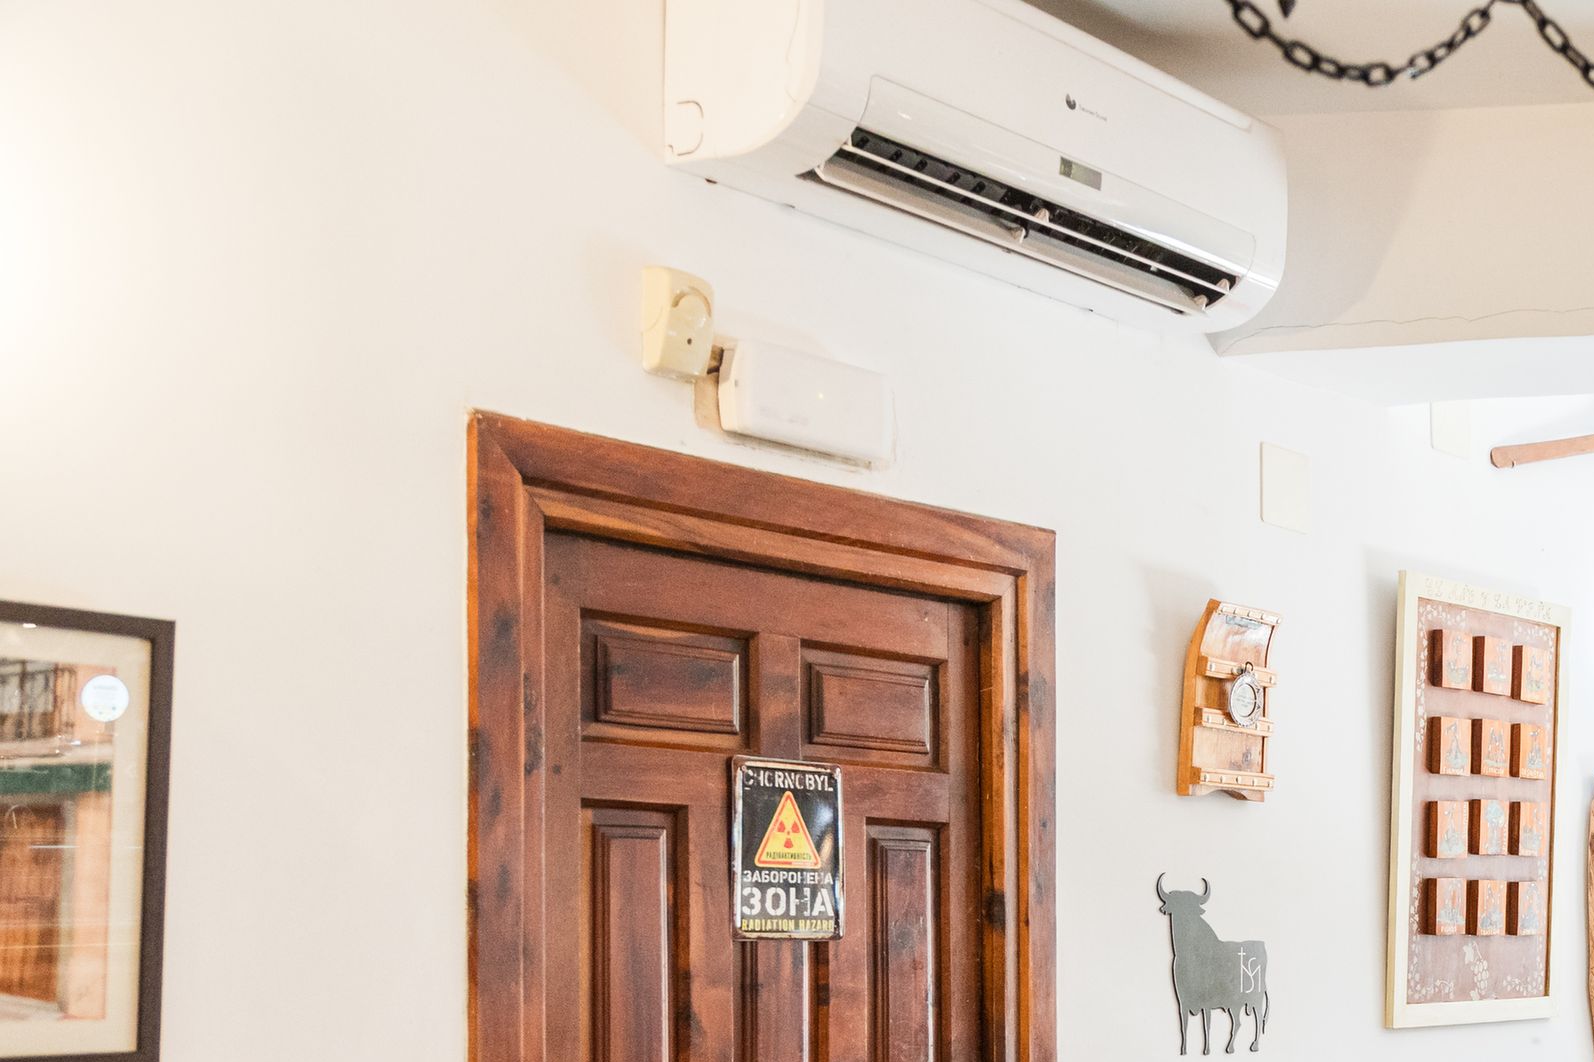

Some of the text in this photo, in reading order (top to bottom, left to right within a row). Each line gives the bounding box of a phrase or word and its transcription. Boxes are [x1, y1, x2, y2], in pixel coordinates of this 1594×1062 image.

[743, 870, 834, 885] ЗАБОРОНЕНА
[742, 887, 834, 916] ЗОНА
[742, 918, 834, 931] RADIATION HAZARD
